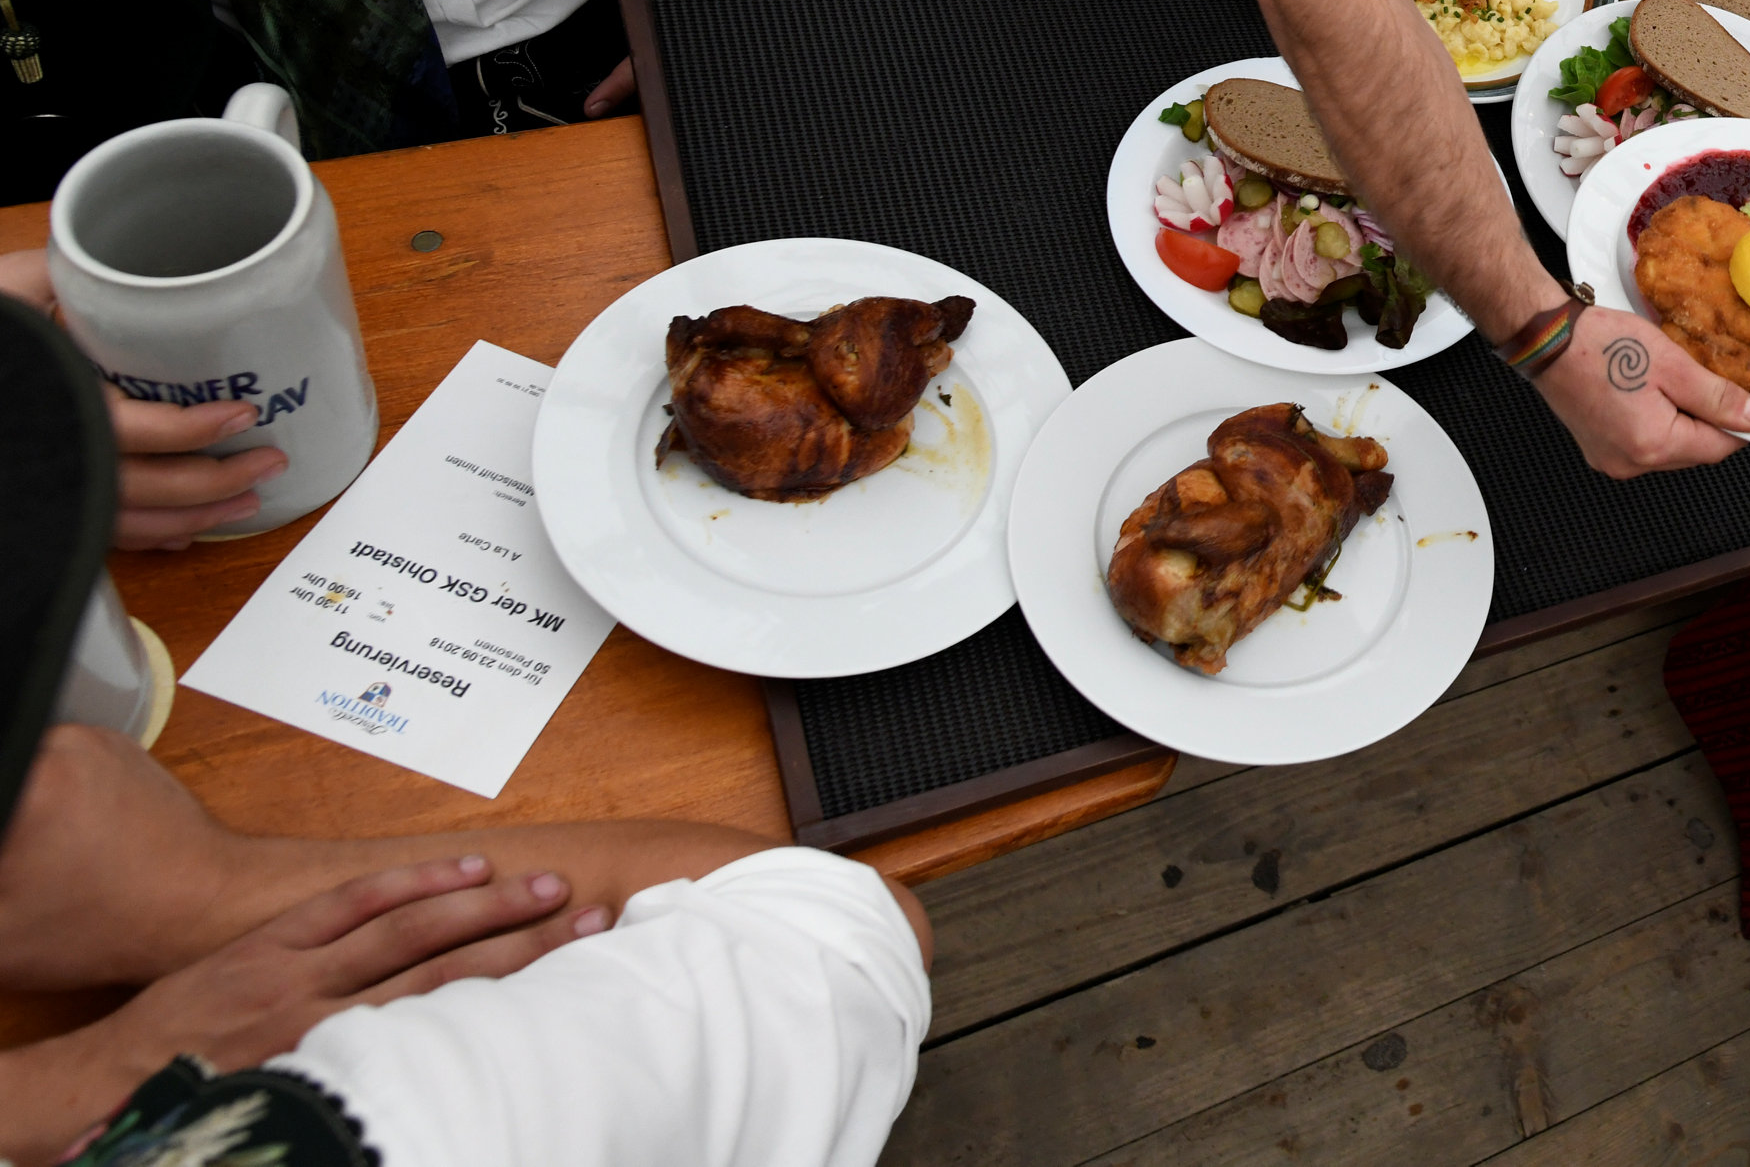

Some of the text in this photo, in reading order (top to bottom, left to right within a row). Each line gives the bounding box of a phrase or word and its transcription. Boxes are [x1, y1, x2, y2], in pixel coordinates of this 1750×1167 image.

[445, 455, 480, 474] hinten
[458, 532, 523, 562] A La Carte
[289, 586, 315, 602] Uhr
[301, 572, 327, 588] Uhr
[326, 581, 362, 601] 16:00
[349, 541, 566, 633] MK der GSK Ohlstadt
[314, 595, 349, 615] 11:30
[329, 630, 472, 698] Reservierung
[429, 637, 543, 686] für den 23.09.2018
[473, 639, 551, 675] 50 Personen
[315, 690, 409, 733] TRADITION
